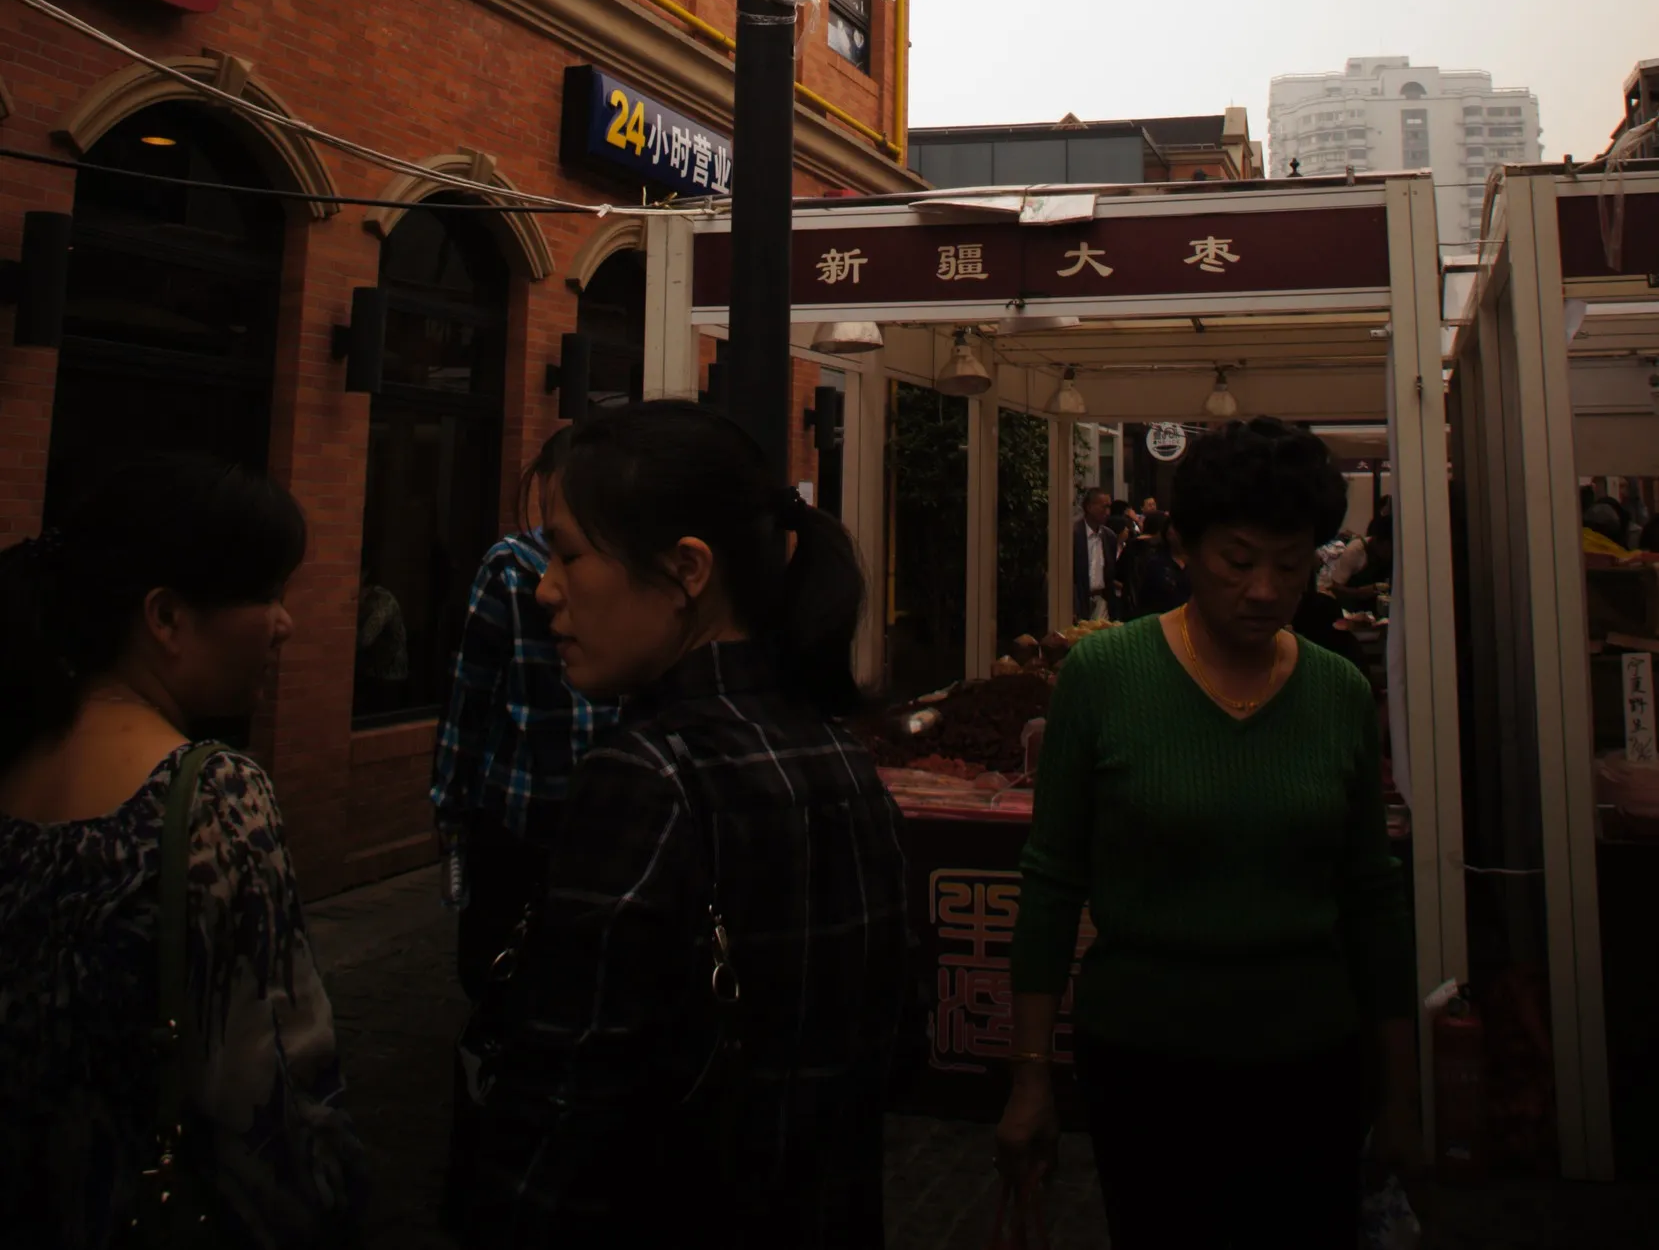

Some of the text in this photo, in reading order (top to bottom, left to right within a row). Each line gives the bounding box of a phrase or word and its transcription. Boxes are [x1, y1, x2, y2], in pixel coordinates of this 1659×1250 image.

[605, 89, 732, 195] 24小时营业
[815, 235, 1241, 285] 新疆大枣
